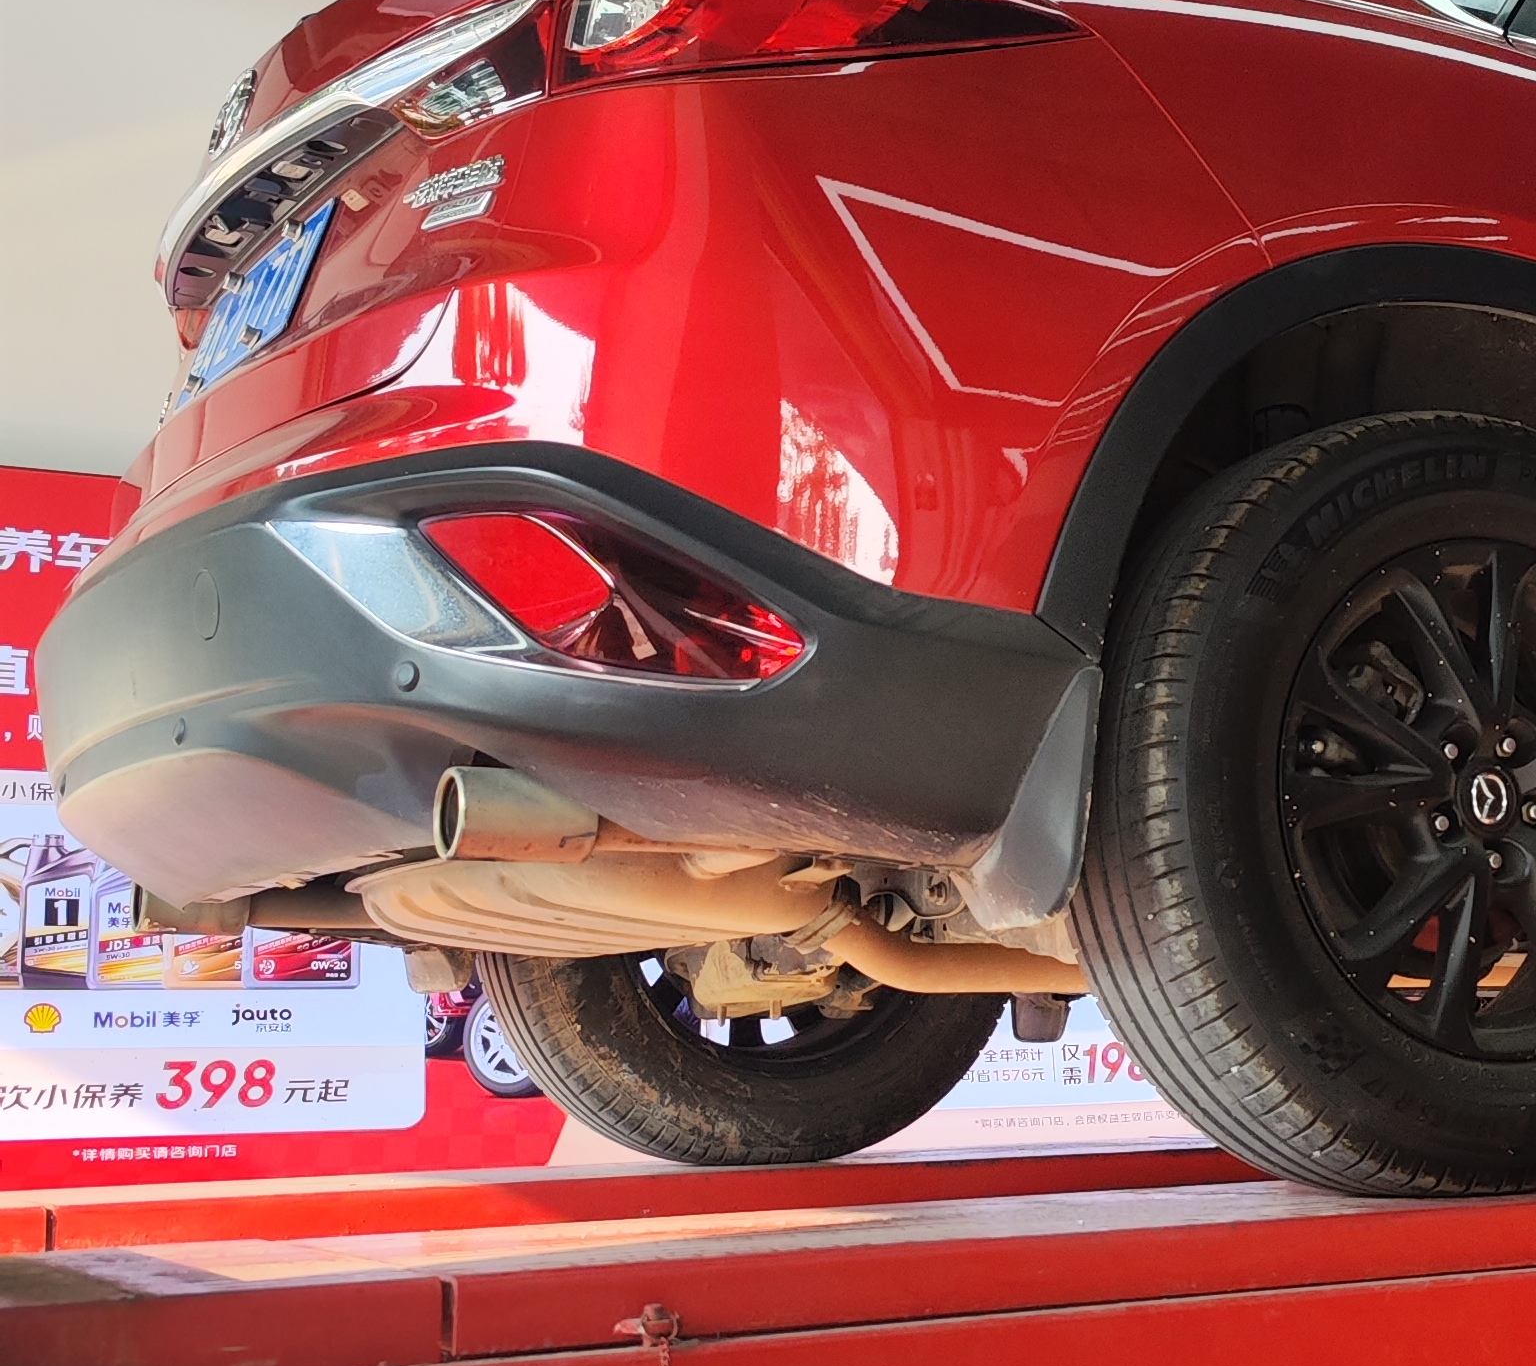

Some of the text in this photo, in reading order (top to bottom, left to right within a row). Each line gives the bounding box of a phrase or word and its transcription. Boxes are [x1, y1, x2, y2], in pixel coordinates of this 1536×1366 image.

[1305, 453, 1487, 547] MICHELIN
[45, 887, 80, 897] Mobil
[310, 960, 348, 970] 0W-20
[93, 1010, 201, 1028] Mobil 美孚
[231, 1003, 292, 1026] jauto
[984, 1048, 1044, 1063] 全年预计
[1061, 1043, 1081, 1062] 仅
[155, 1059, 277, 1110] 398
[283, 1079, 350, 1105] 元起
[1062, 1067, 1082, 1085] 需
